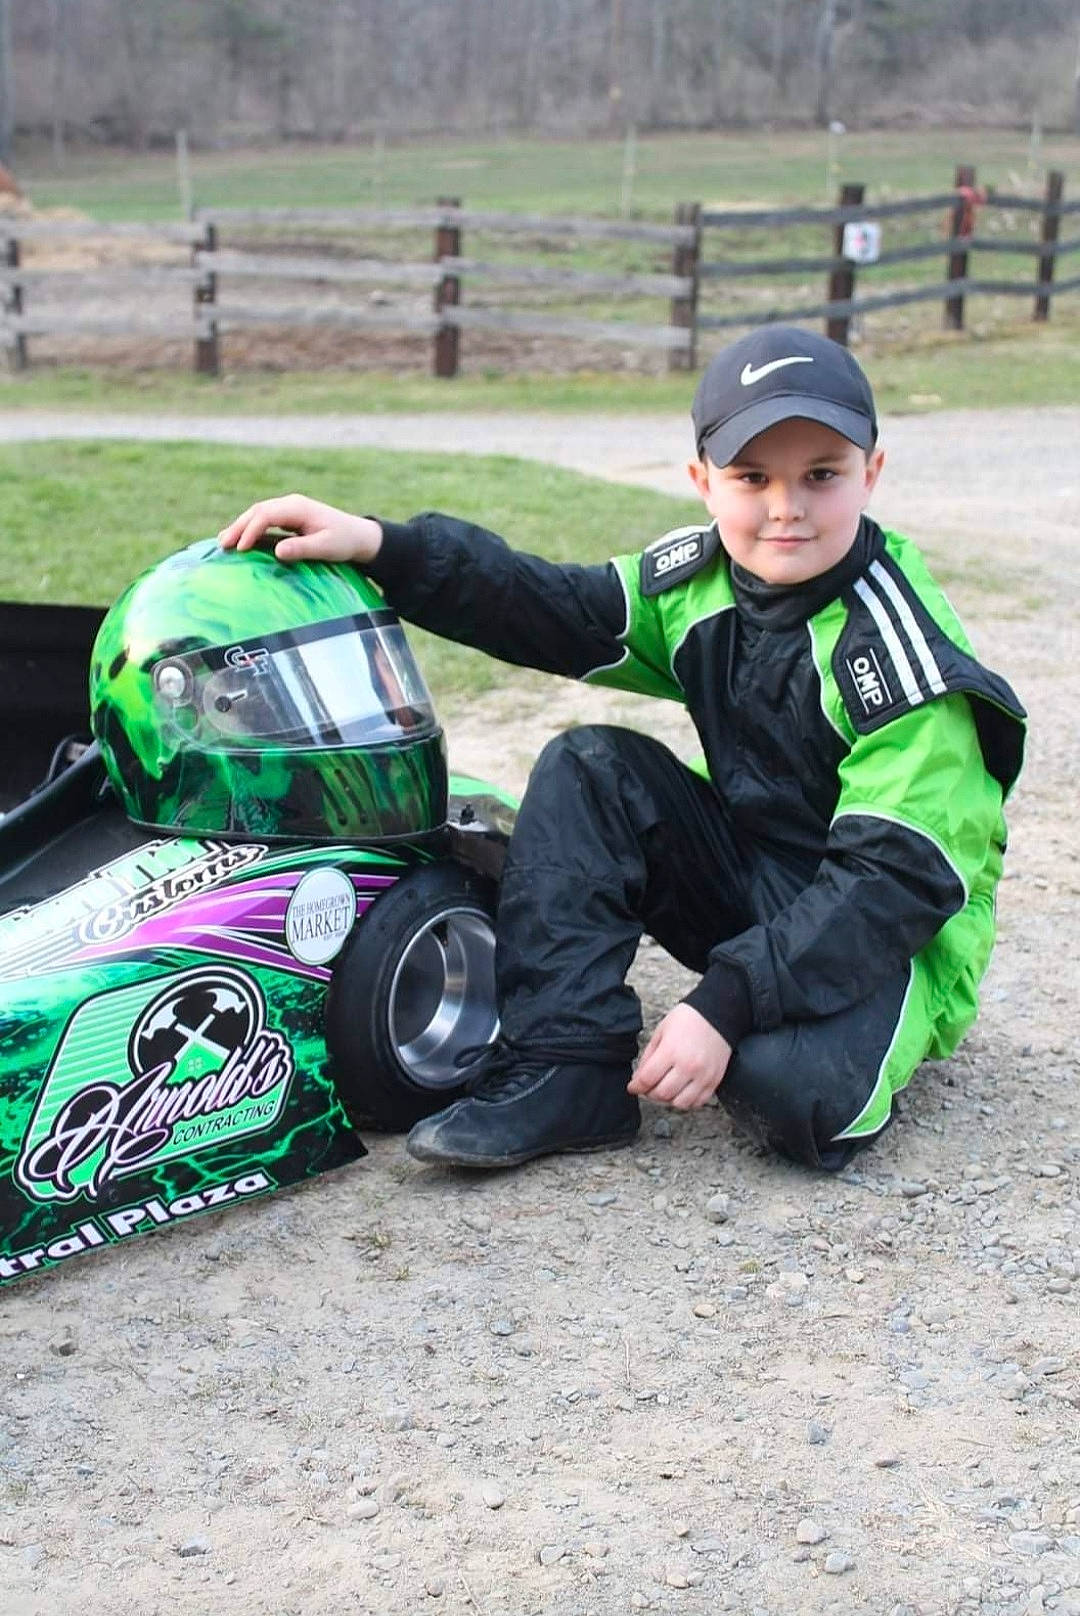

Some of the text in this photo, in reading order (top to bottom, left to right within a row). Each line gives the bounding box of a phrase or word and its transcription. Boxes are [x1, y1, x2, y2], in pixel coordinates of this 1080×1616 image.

[656, 541, 699, 570] OMP
[854, 657, 884, 706] OMP
[292, 905, 350, 943] MARKET
[29, 1038, 284, 1195] Arnold's
[173, 1101, 275, 1145] CONTRACTING
[108, 1173, 270, 1236] Plaza
